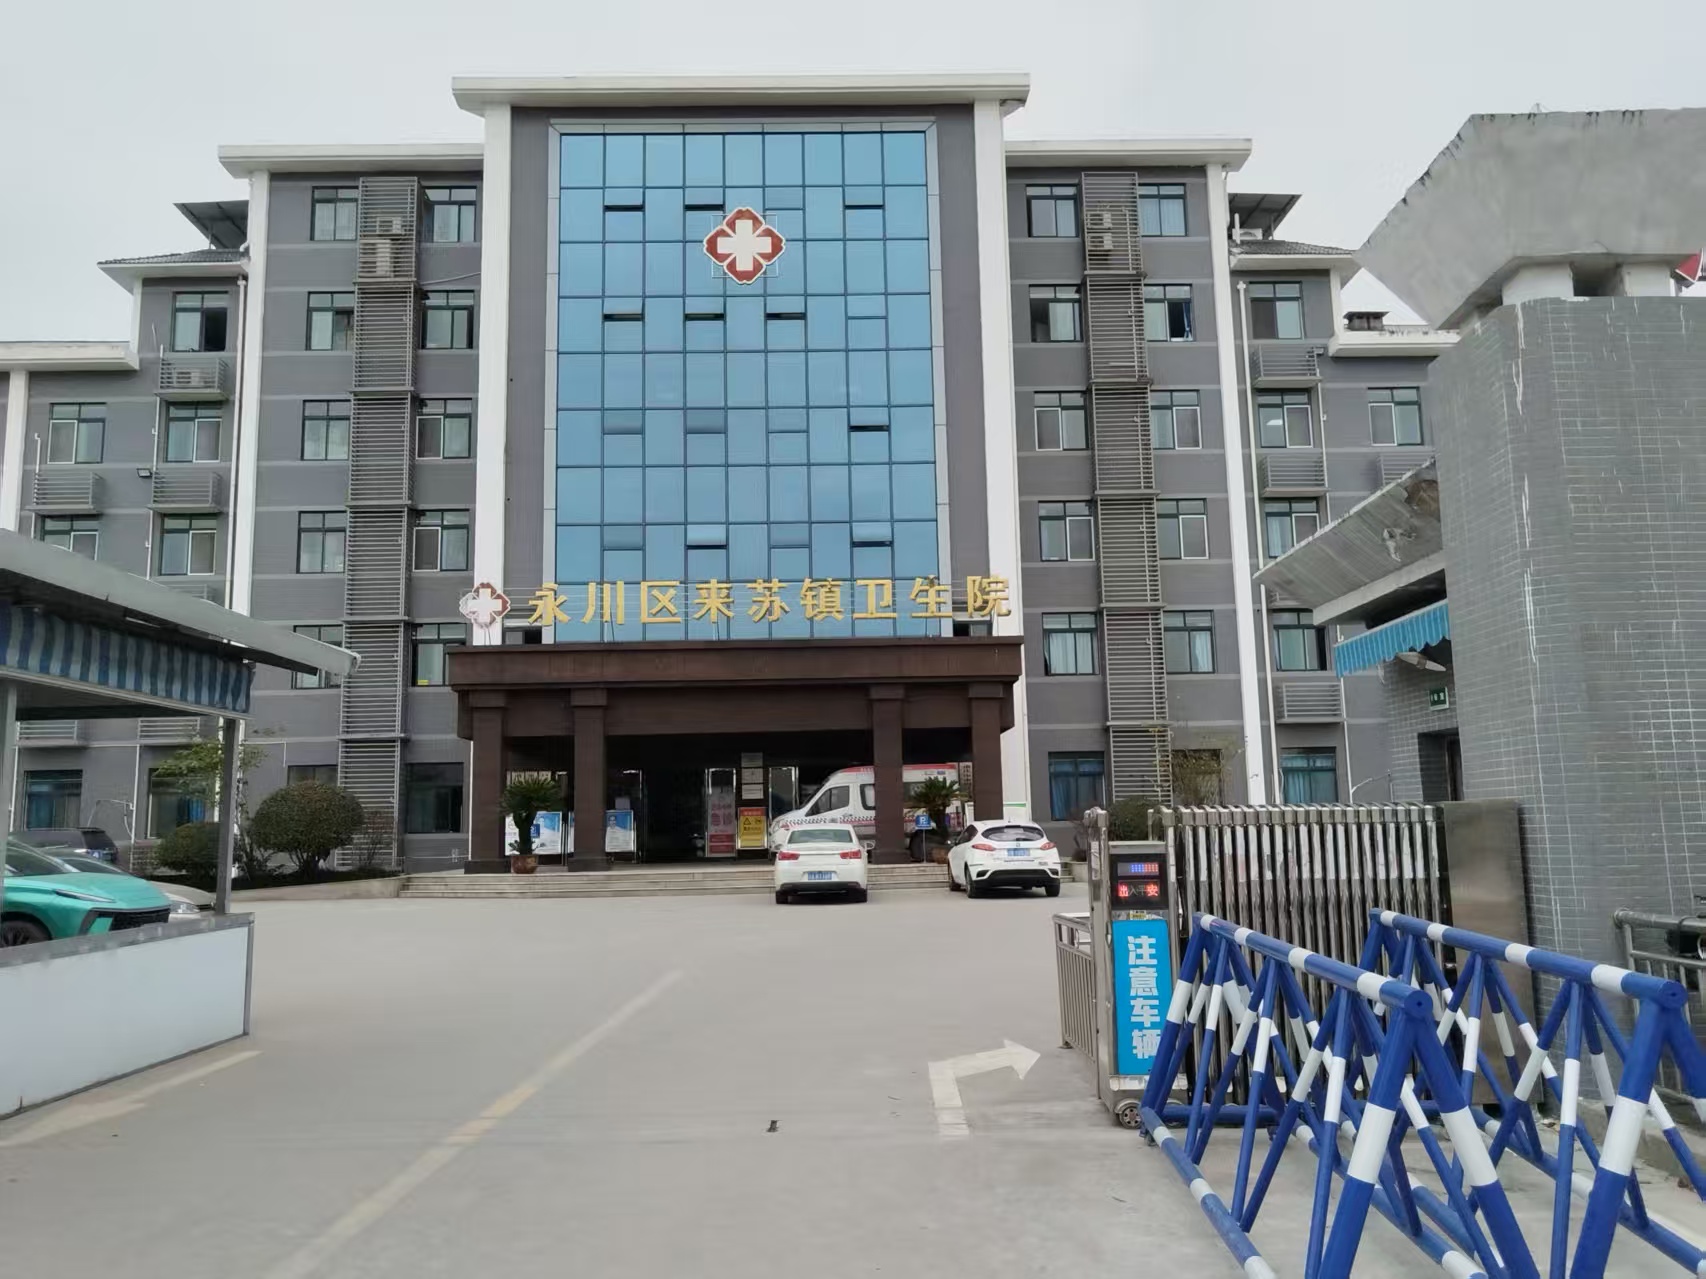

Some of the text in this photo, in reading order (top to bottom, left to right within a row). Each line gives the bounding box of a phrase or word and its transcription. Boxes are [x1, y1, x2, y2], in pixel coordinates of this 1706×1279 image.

[528, 574, 1012, 625] 永川区来苏镇卫生院
[1118, 883, 1159, 897] 出入平安
[1127, 935, 1161, 1060] 注意车辆
